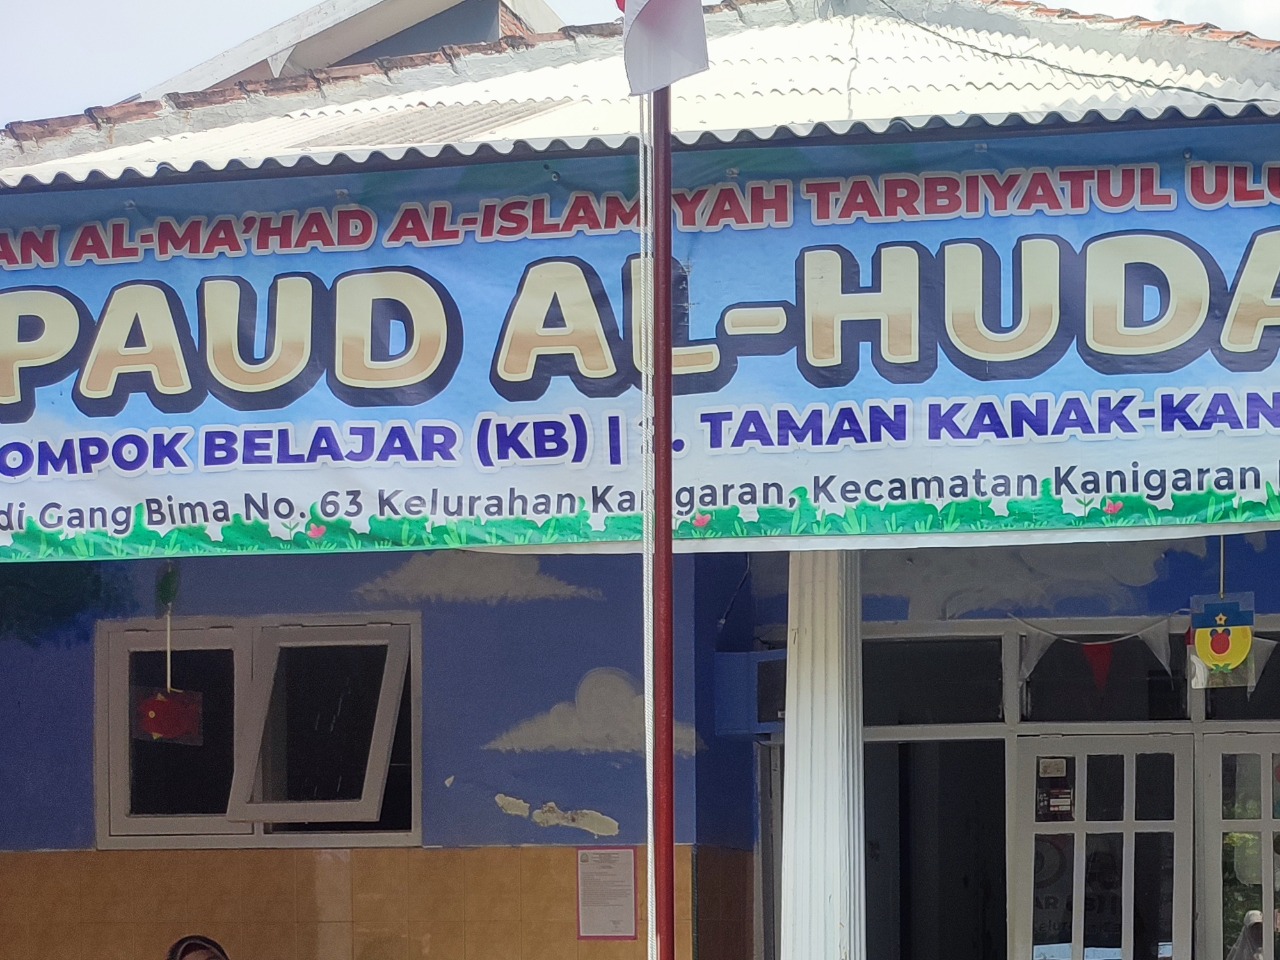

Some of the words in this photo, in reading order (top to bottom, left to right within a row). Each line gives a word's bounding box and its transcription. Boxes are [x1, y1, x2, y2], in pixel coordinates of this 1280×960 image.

[387, 184, 788, 243] AL-ISLAMYAH
[805, 167, 1172, 221] TARBIYATUL
[0, 269, 453, 408] PAUD
[0, 431, 190, 478] OMPOK
[203, 425, 458, 467] BELAJAR
[476, 413, 589, 468] (KB)
[699, 403, 906, 449] TAMAN
[0, 501, 26, 531] di
[38, 501, 132, 535] Gang
[145, 494, 231, 526] Bima
[243, 492, 306, 521] No.
[320, 489, 363, 518] 63
[377, 487, 577, 517] Kelurahan
[591, 480, 795, 517] Kagaran,
[813, 468, 1037, 503] Kecamatan
[1053, 460, 1261, 501] Kanigaran
